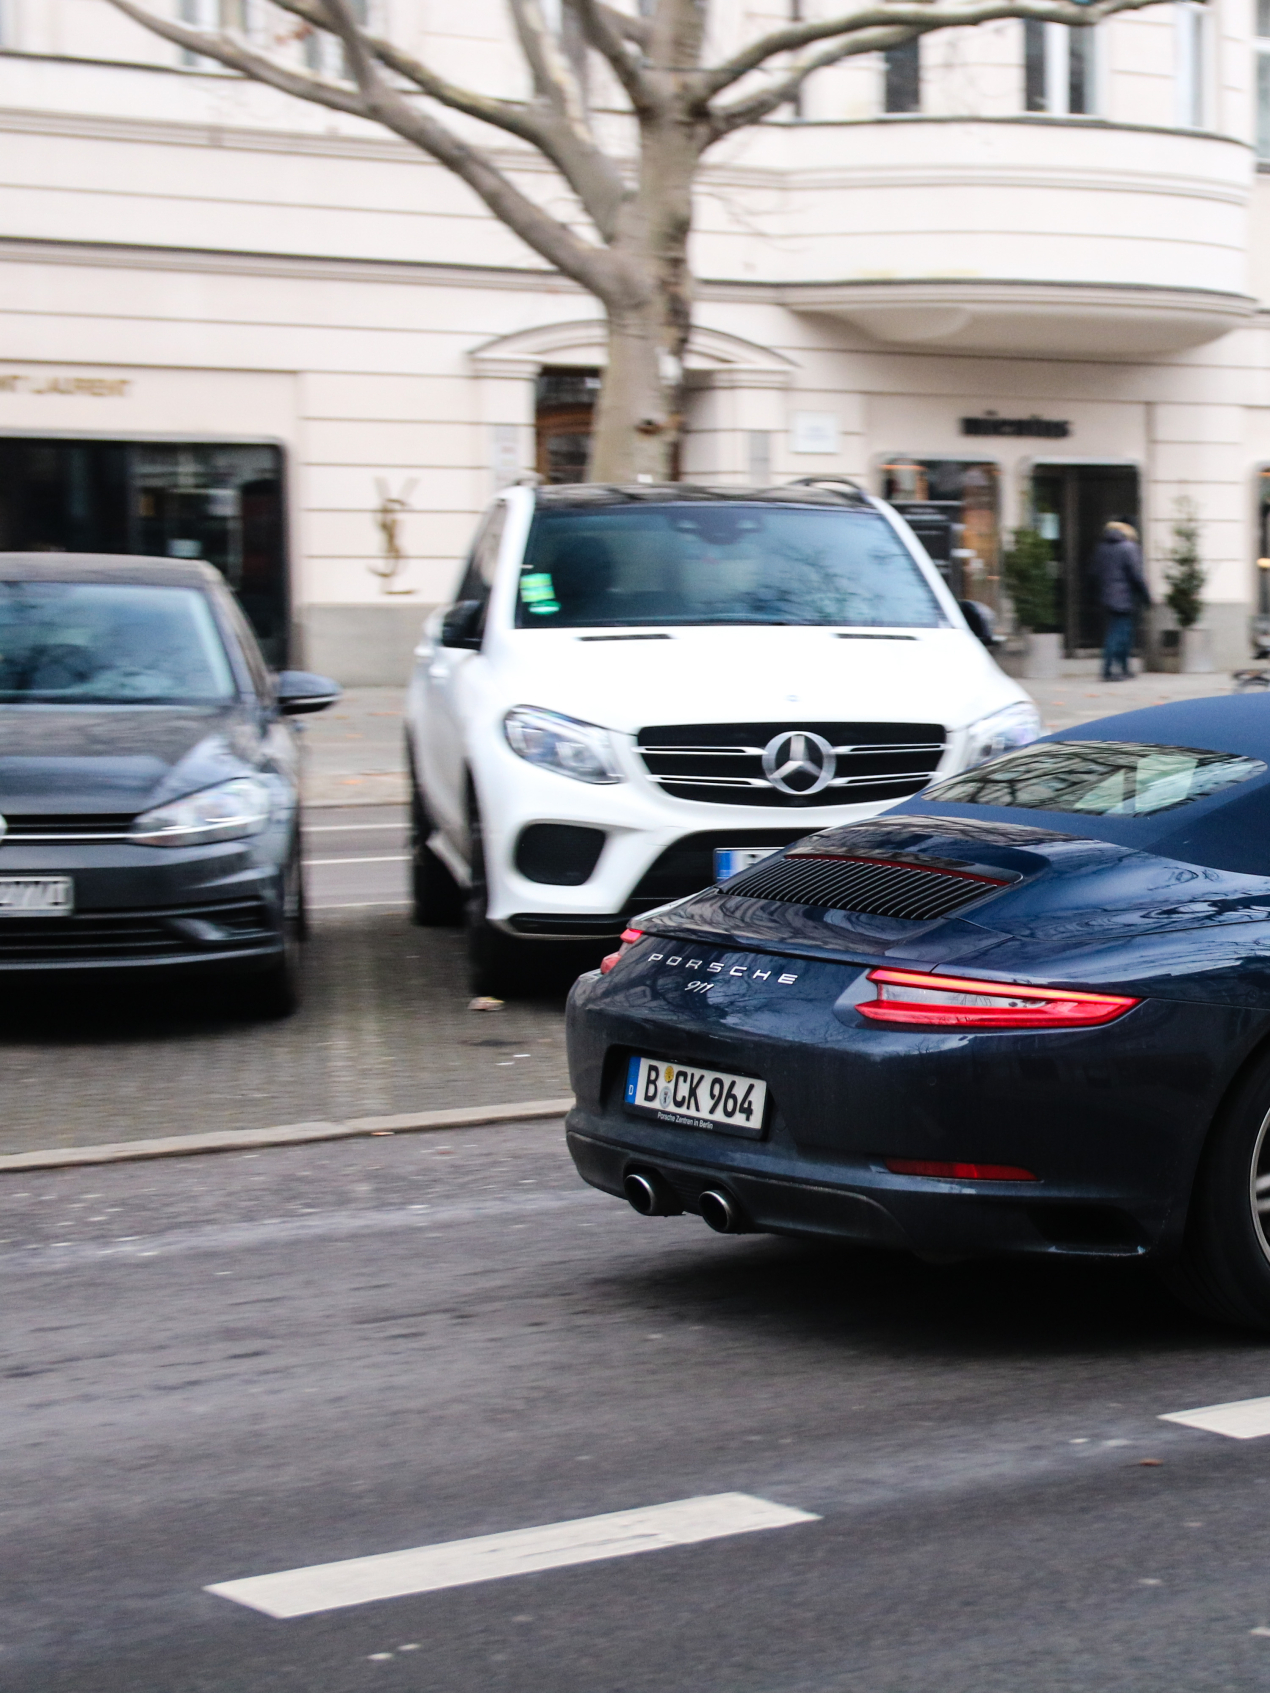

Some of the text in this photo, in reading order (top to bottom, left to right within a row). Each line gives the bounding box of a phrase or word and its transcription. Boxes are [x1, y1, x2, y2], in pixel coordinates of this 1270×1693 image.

[648, 953, 798, 984] PORSCHE
[684, 980, 715, 994] 911
[628, 1084, 634, 1096] D
[644, 1064, 755, 1122] B CK 964
[657, 1111, 675, 1122] Porsche
[693, 1118, 699, 1127] in
[699, 1119, 713, 1130] Berlin
